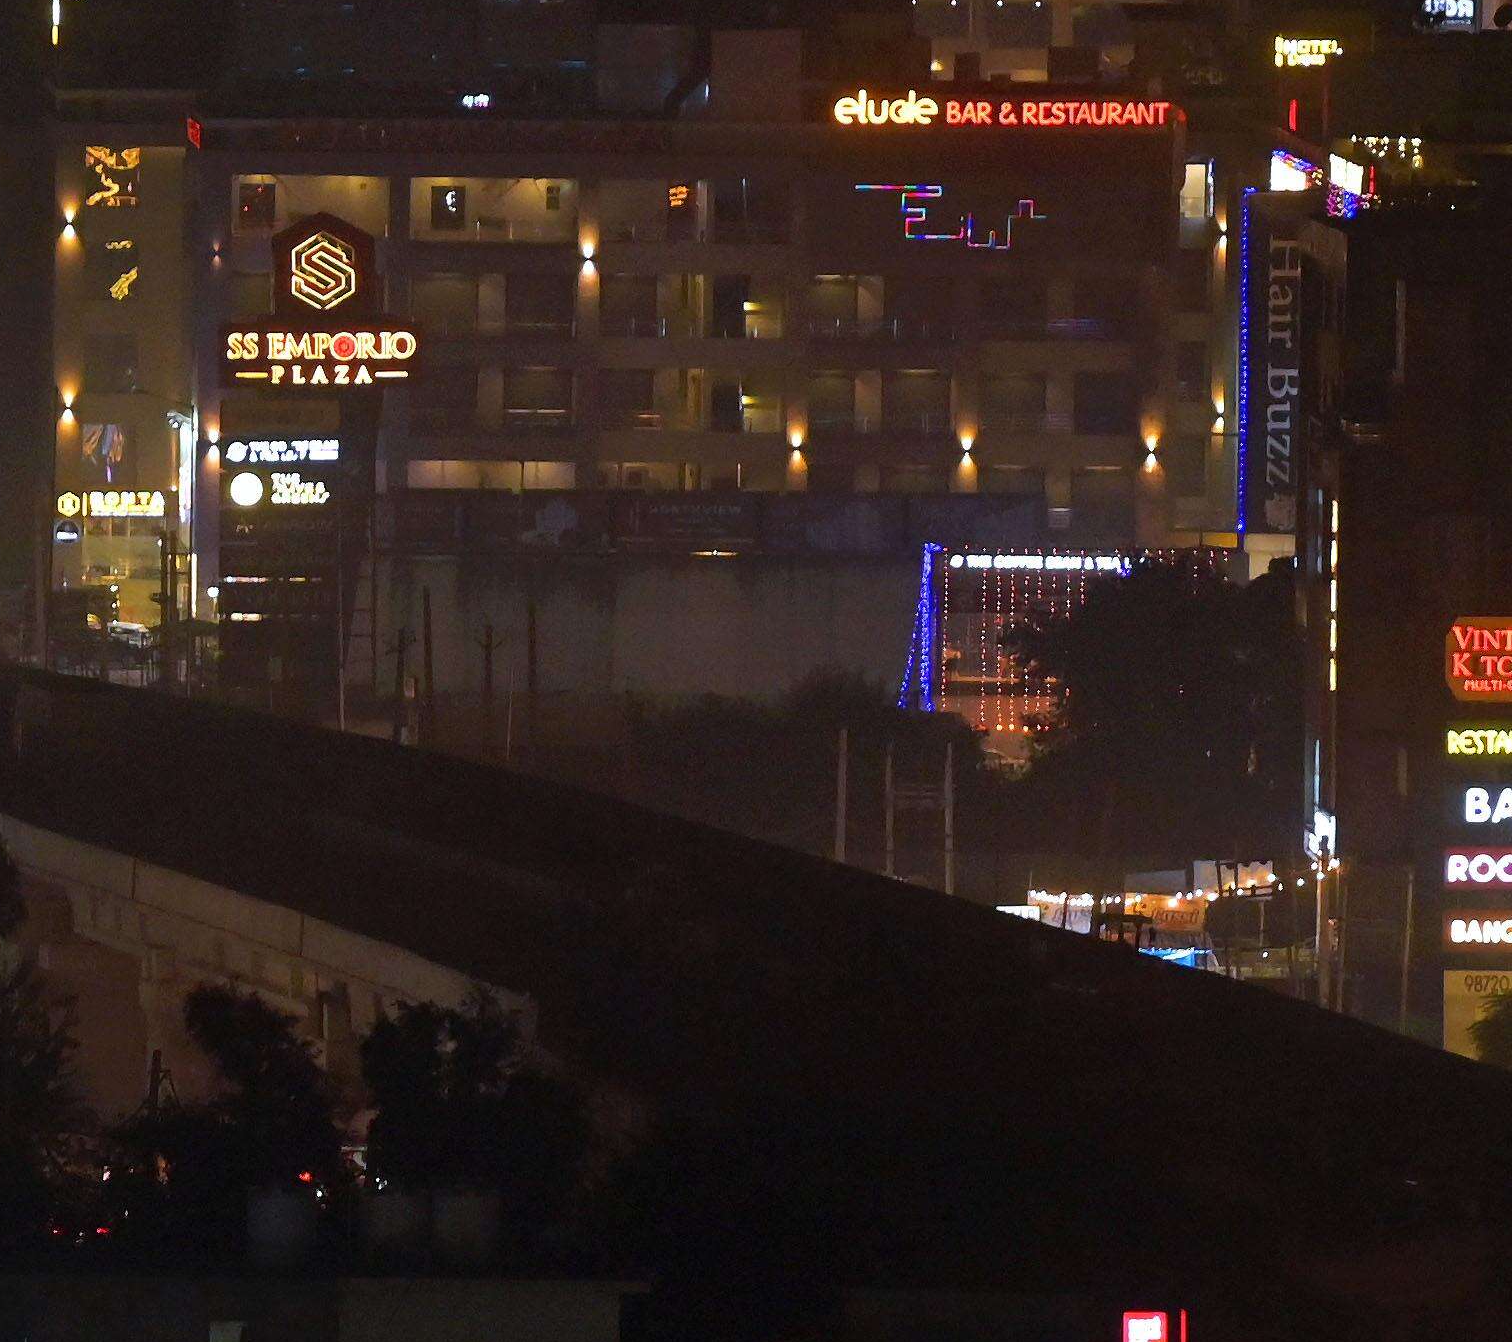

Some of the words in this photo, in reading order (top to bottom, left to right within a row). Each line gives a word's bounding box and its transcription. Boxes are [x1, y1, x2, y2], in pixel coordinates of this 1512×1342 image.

[834, 89, 939, 125] elude
[946, 101, 994, 125] BAR
[998, 102, 1018, 125] &
[1022, 101, 1170, 125] RESTAURANT
[1268, 234, 1302, 349] Hair
[227, 332, 259, 360] SS
[267, 331, 416, 361] EMPORIO
[270, 364, 373, 384] PLAZA
[1265, 362, 1300, 486] Buzz
